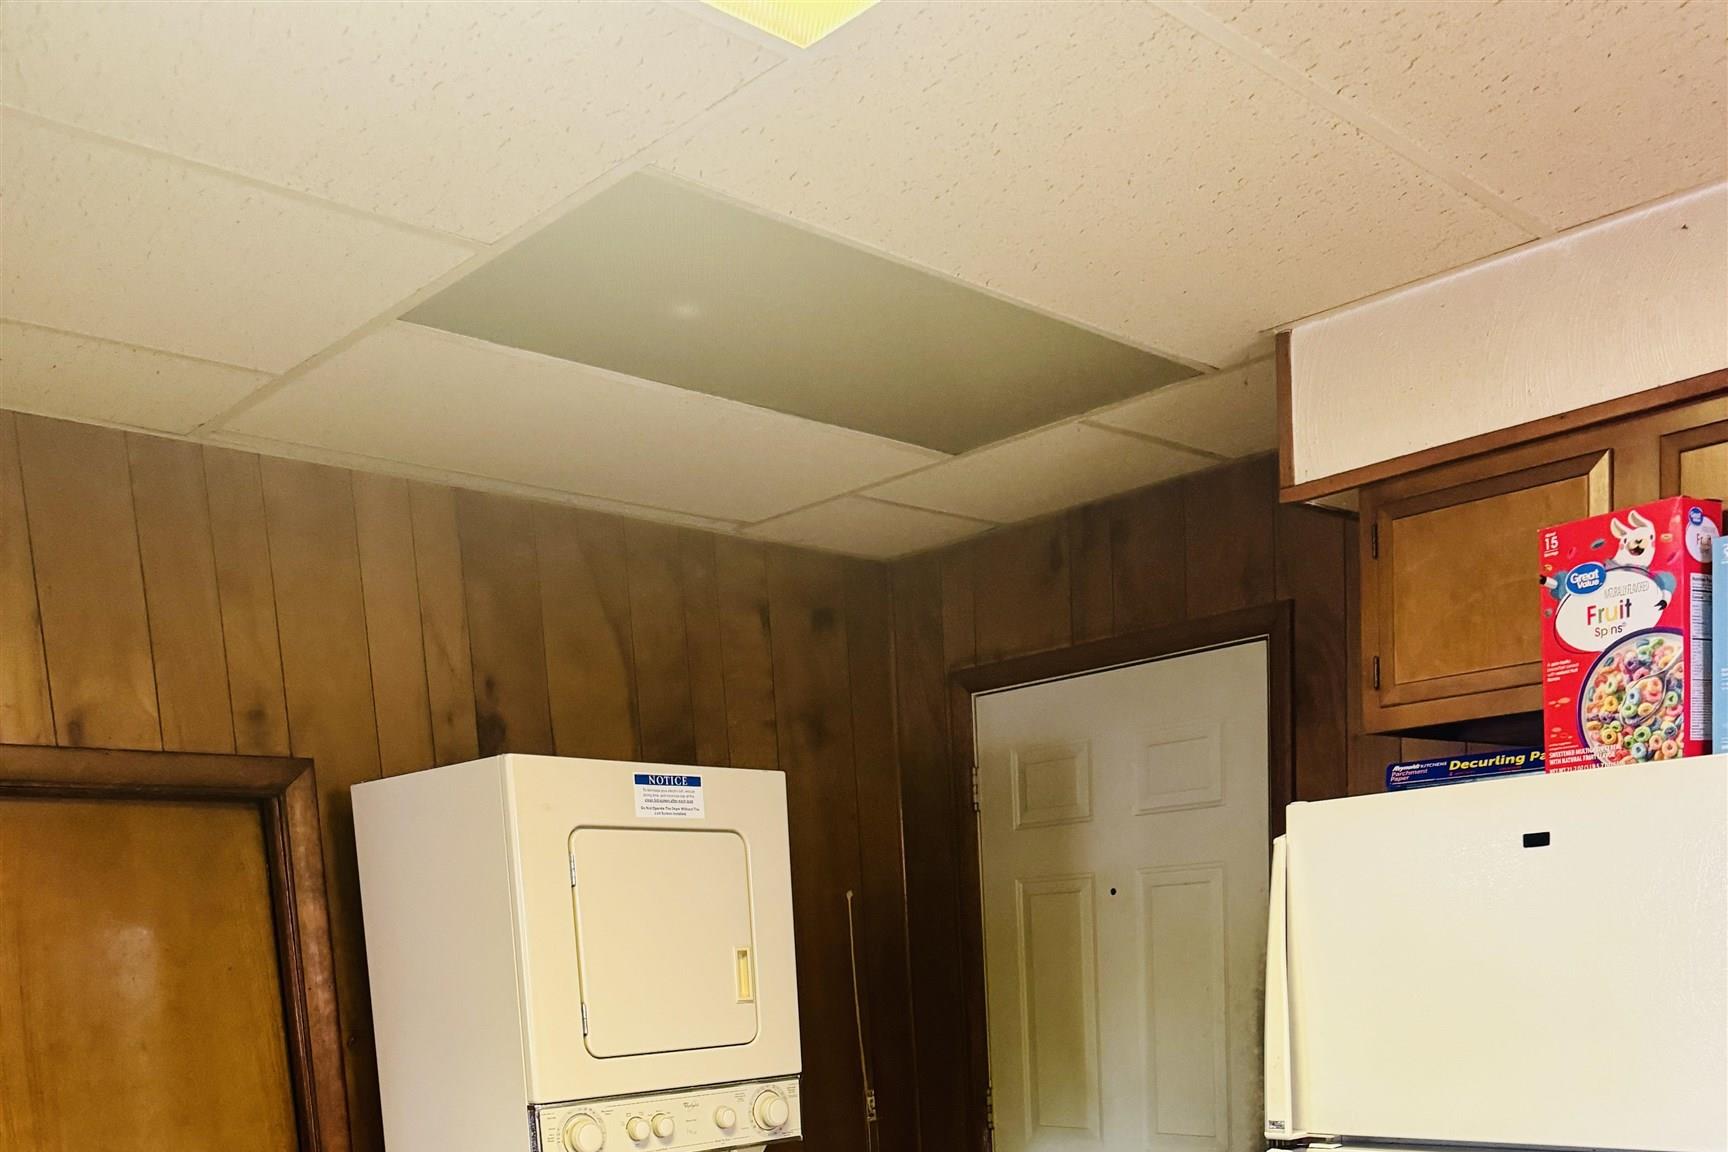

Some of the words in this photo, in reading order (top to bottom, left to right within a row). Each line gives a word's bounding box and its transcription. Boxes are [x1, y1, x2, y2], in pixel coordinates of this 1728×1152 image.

[1545, 536, 1559, 550] 15
[1570, 569, 1600, 584] Great
[1577, 579, 1600, 589] Value
[1587, 598, 1632, 625] Fruit
[1449, 755, 1526, 770] Decurling
[648, 775, 688, 785] NOTICE
[1392, 769, 1428, 777] Parchment
